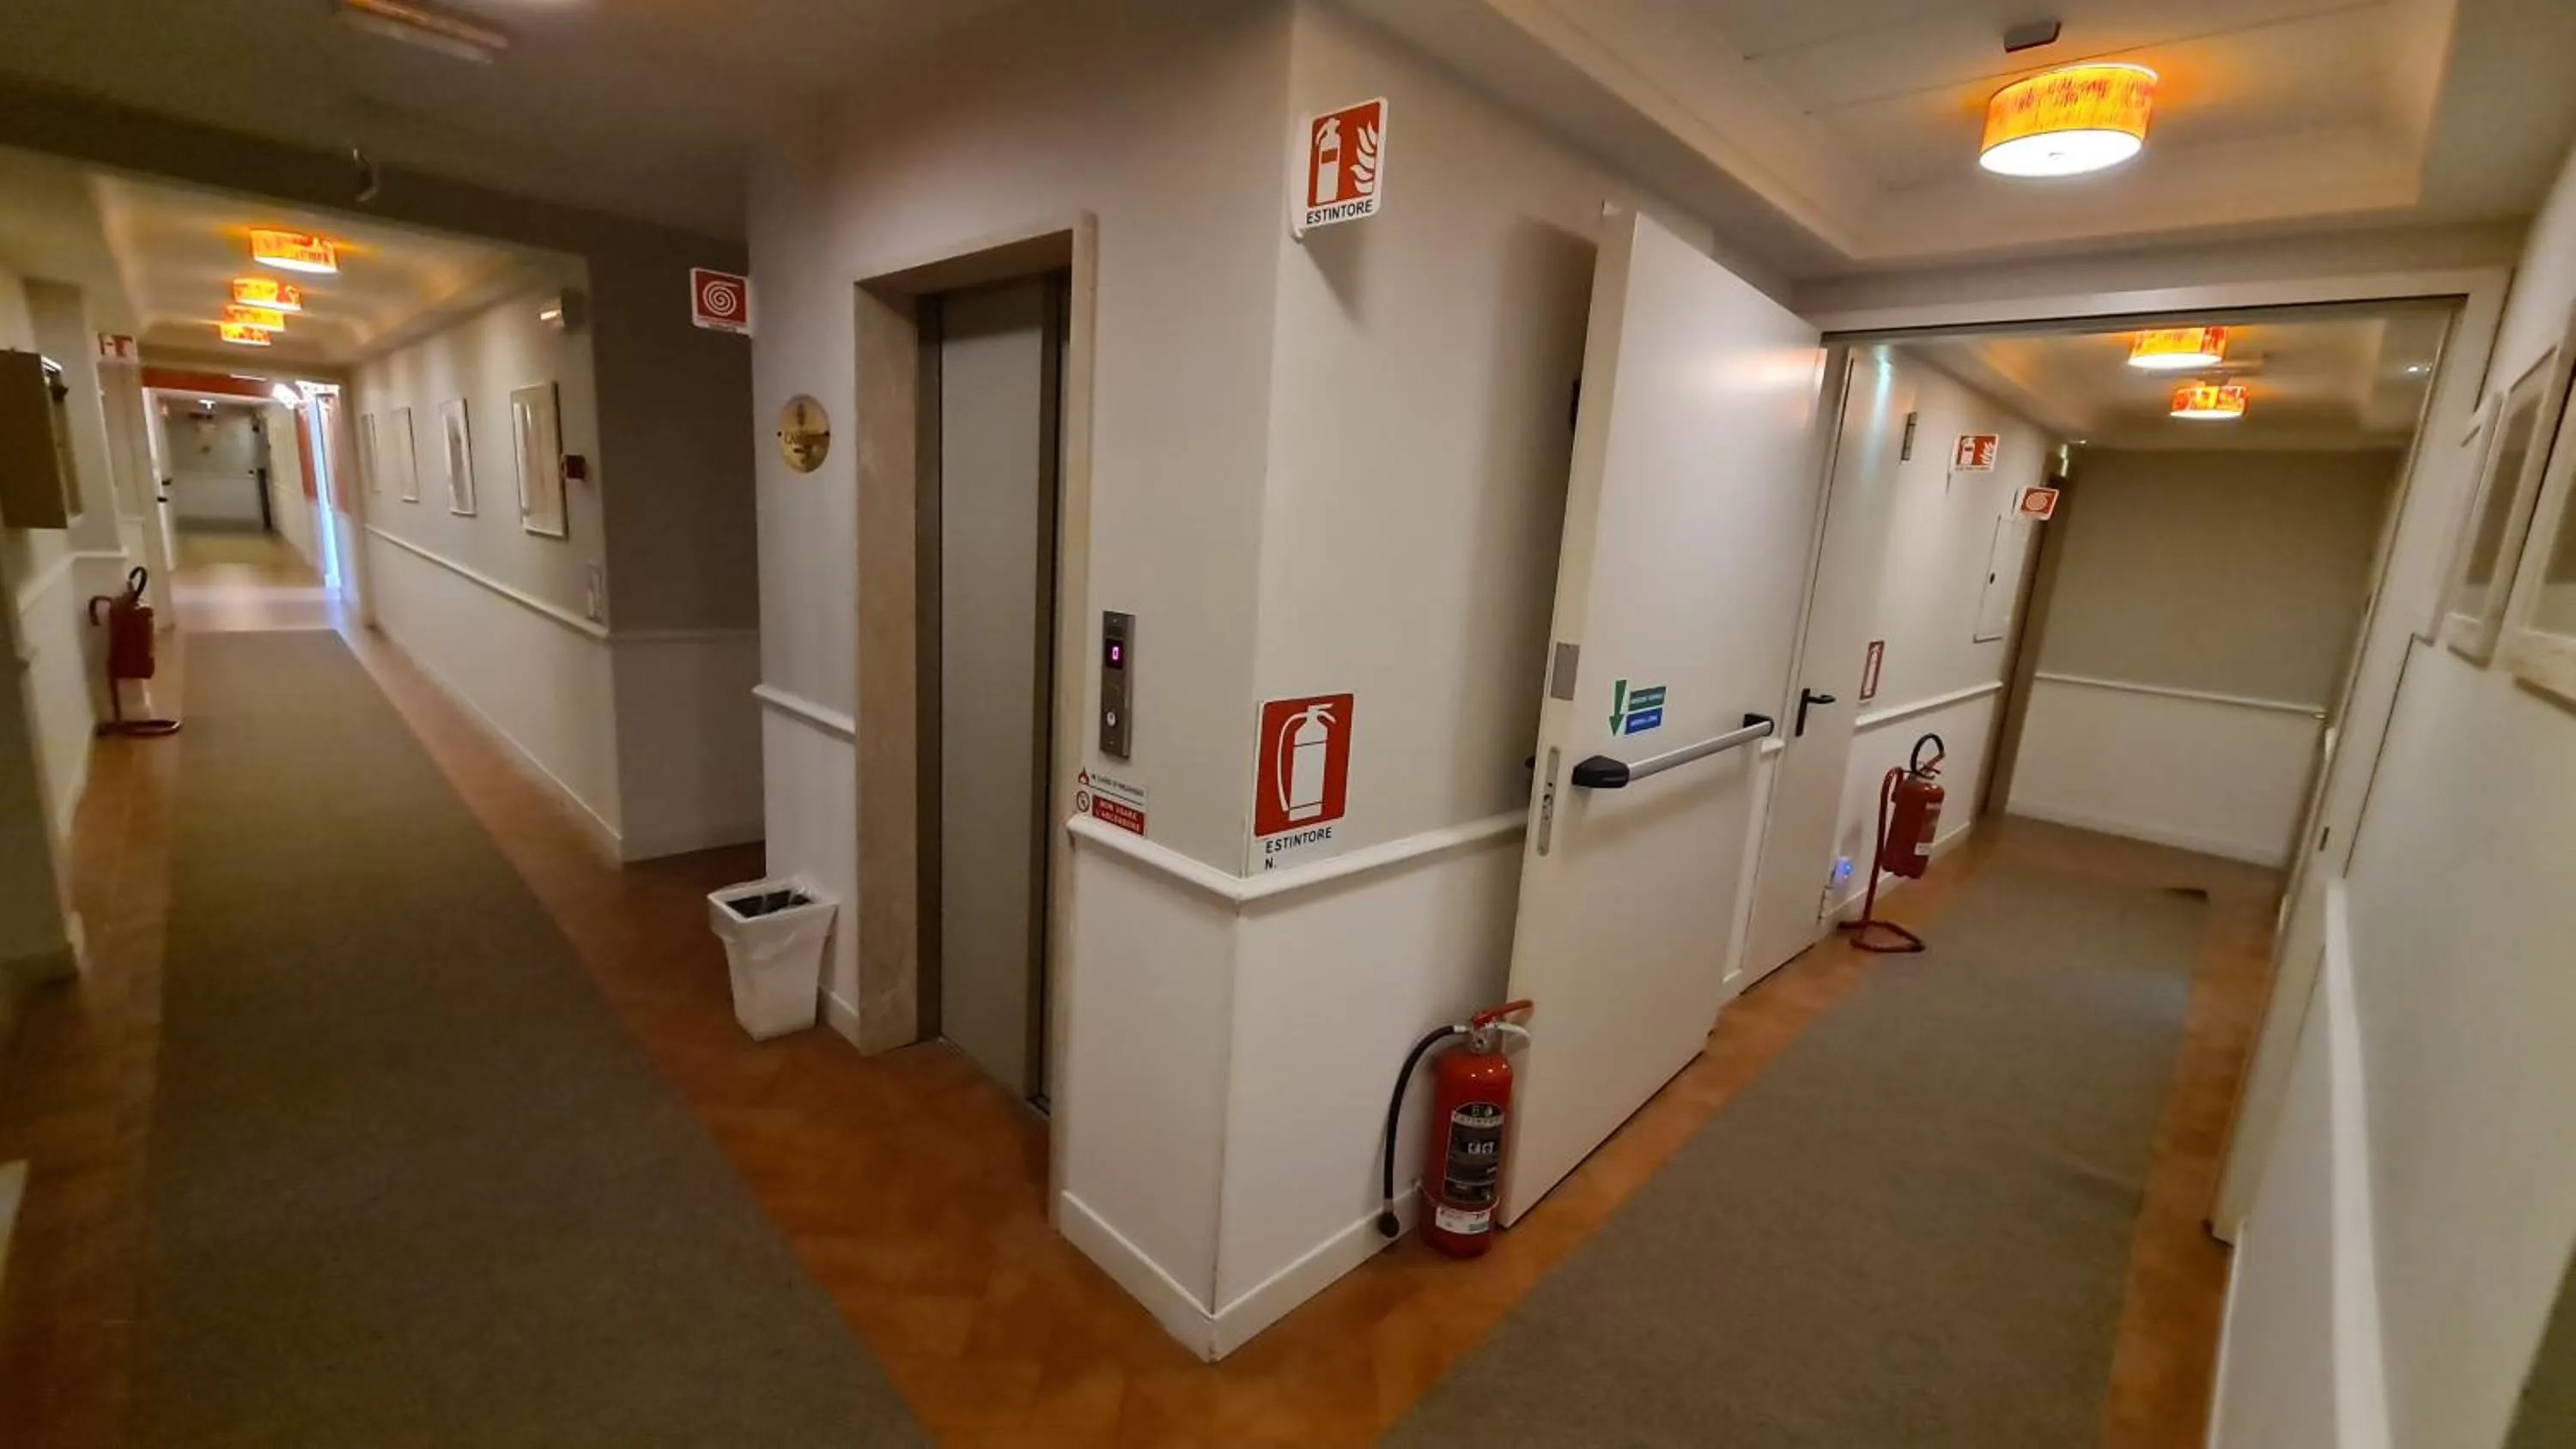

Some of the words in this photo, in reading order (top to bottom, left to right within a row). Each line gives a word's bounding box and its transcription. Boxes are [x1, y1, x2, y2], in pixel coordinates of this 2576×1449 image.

[1306, 199, 1373, 225] ESTINTORE
[1265, 827, 1333, 854] ESTINTORE
[1265, 858, 1278, 870] N.
